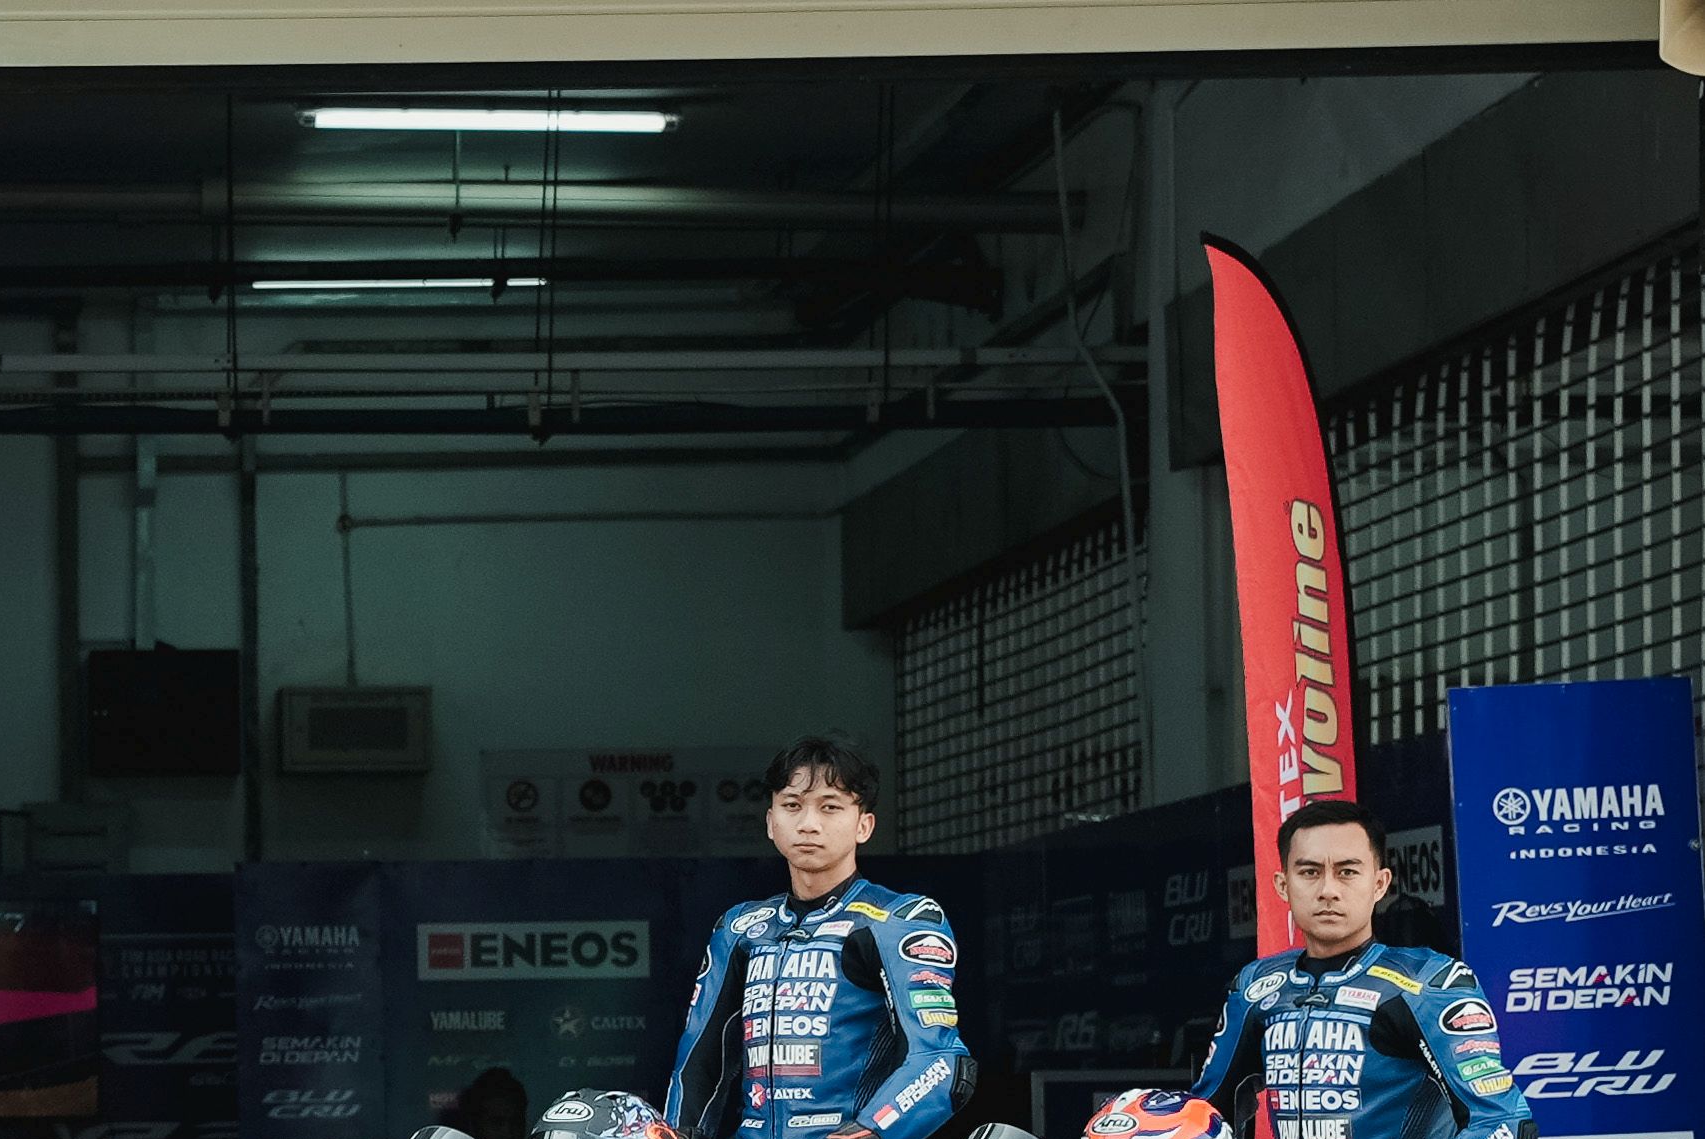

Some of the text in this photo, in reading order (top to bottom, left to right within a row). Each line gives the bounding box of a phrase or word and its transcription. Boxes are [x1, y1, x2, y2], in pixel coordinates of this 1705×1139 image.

[1293, 499, 1343, 803] voline
[589, 753, 673, 773] WARNING
[1531, 784, 1665, 821] YAMAHA
[1509, 821, 1656, 835] RACING
[1510, 844, 1657, 859] INDONESIA
[1492, 901, 1563, 927] Revs
[1565, 900, 1616, 922] Your
[278, 927, 360, 947] YAMAHA
[471, 930, 638, 967] ENEOS
[1508, 963, 1673, 989] SEMAKIN
[1546, 986, 1671, 1011] DEPAN
[431, 1010, 505, 1030] YAMALUBE
[592, 1015, 646, 1030] CALTEX
[752, 1015, 828, 1038] ENEOS
[262, 1036, 362, 1050] SEMAKIN
[283, 1049, 360, 1064] DEPAN
[1266, 1054, 1366, 1070] SEMAKIN
[1512, 1050, 1665, 1075] BLU
[1524, 1073, 1677, 1099] CRU
[1280, 1090, 1360, 1111] ENEOS
[268, 1104, 360, 1119] CRU
